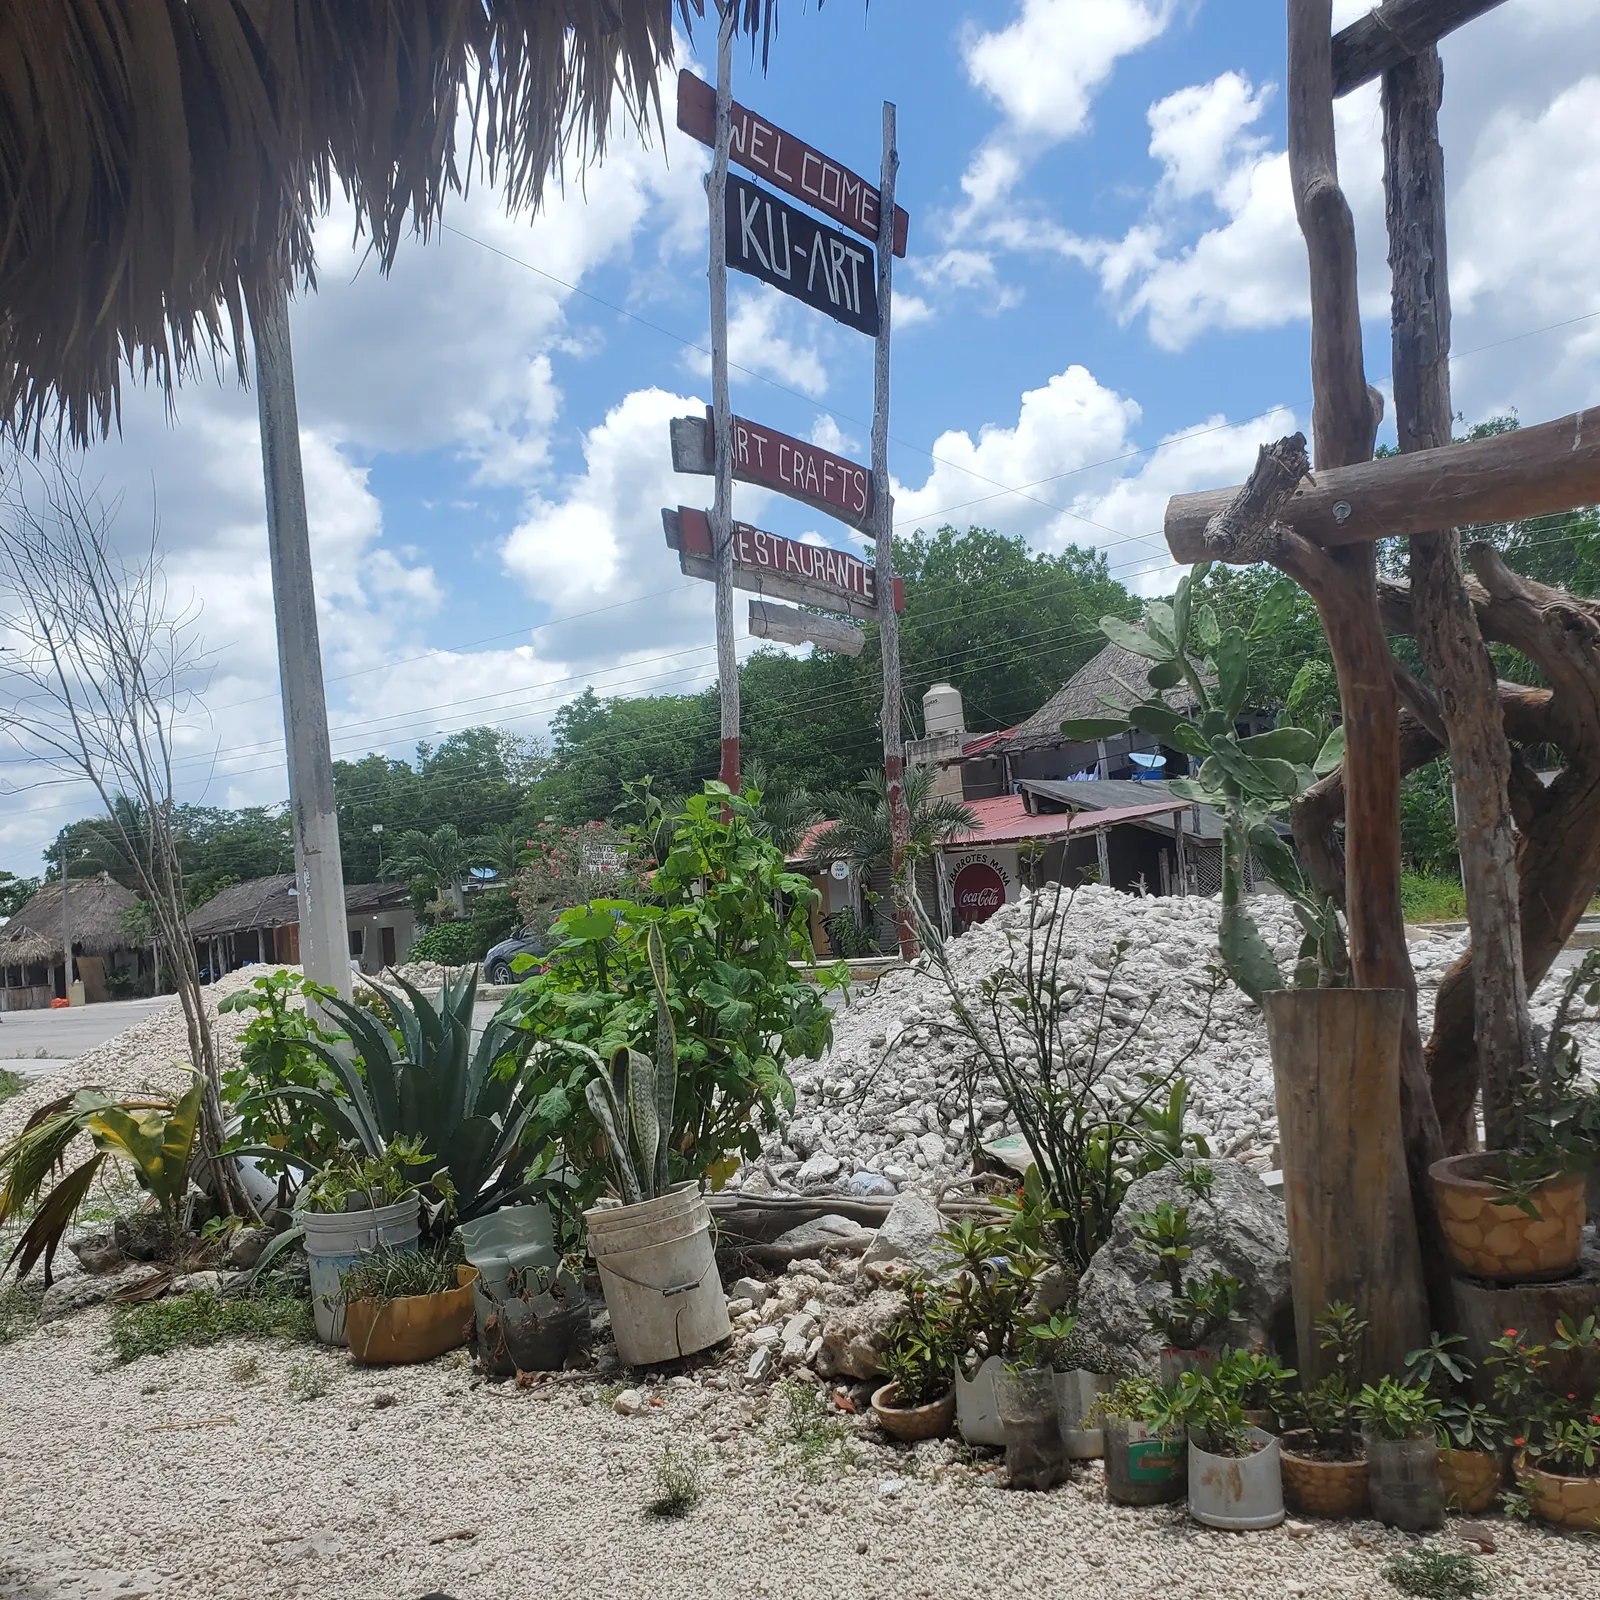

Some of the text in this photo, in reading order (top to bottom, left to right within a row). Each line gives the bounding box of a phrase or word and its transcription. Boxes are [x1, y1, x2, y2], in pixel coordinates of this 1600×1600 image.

[729, 115, 879, 231] WELCOME
[739, 187, 865, 314] KU-ART
[731, 427, 866, 512] RT CRAFTS
[948, 854, 988, 888] ABARROTES
